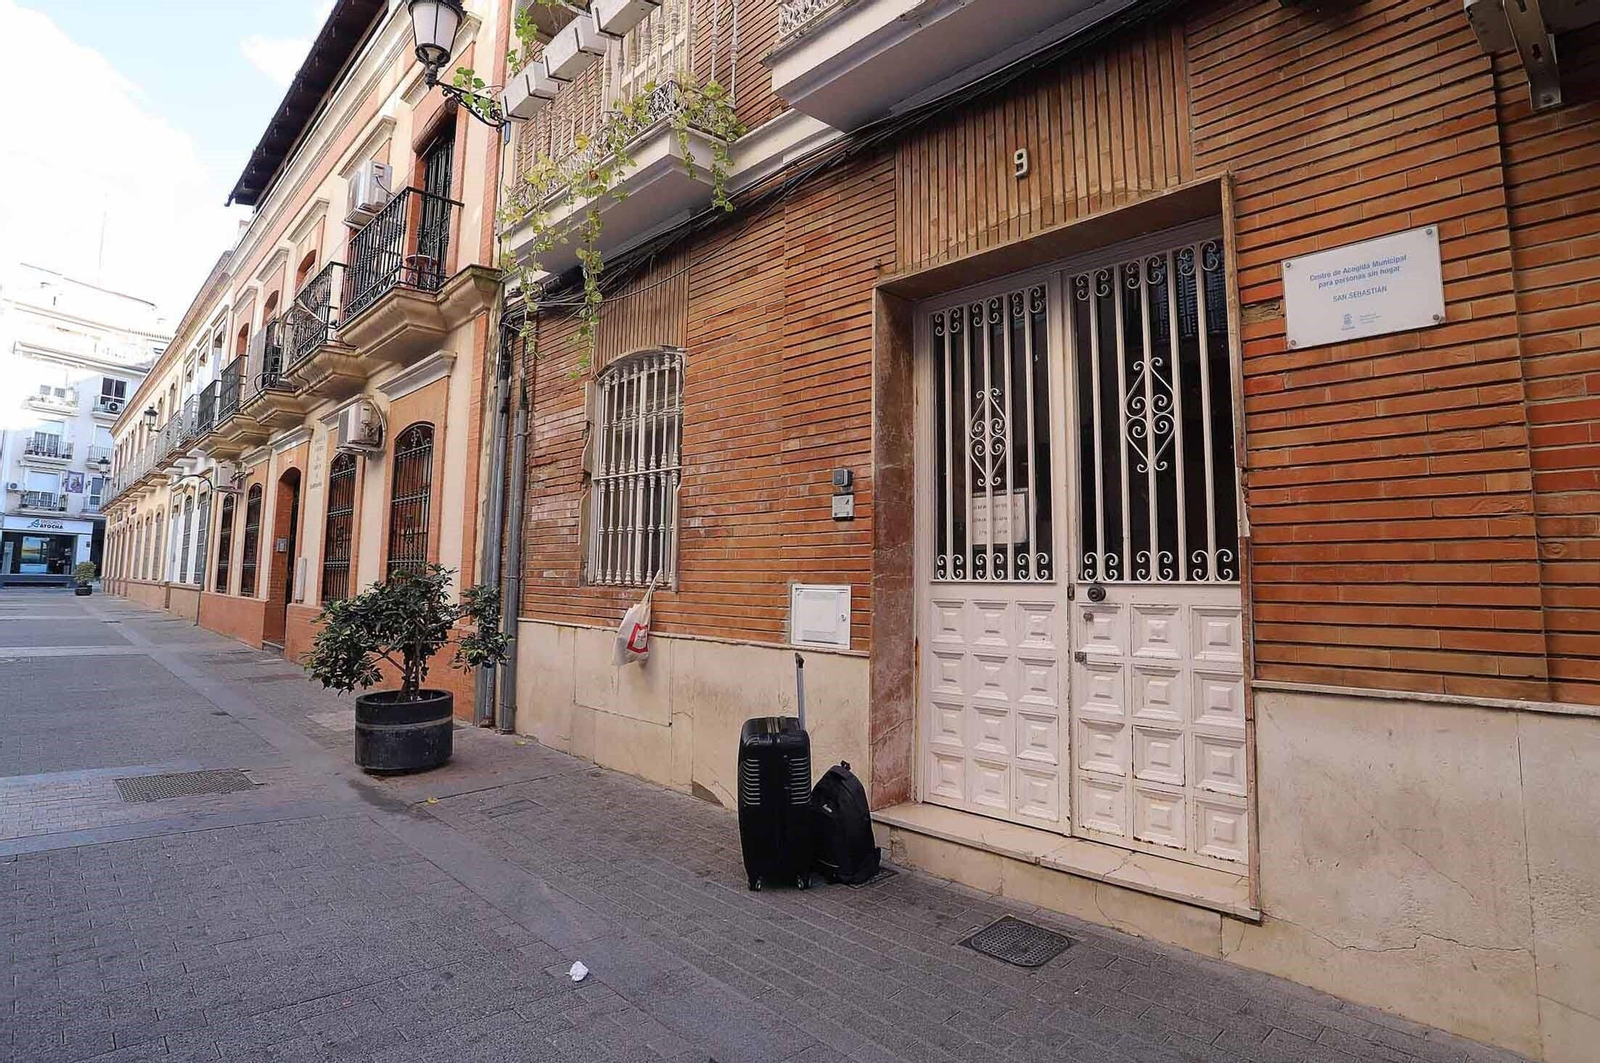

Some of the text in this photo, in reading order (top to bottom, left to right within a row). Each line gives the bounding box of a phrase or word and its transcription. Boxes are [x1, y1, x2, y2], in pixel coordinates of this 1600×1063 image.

[1013, 148, 1028, 175] 9
[1310, 254, 1407, 282] Centro de Acogida Municipal
[1318, 265, 1400, 290] para personas sin hogar
[1333, 286, 1387, 302] SAN SEBASTIÁN
